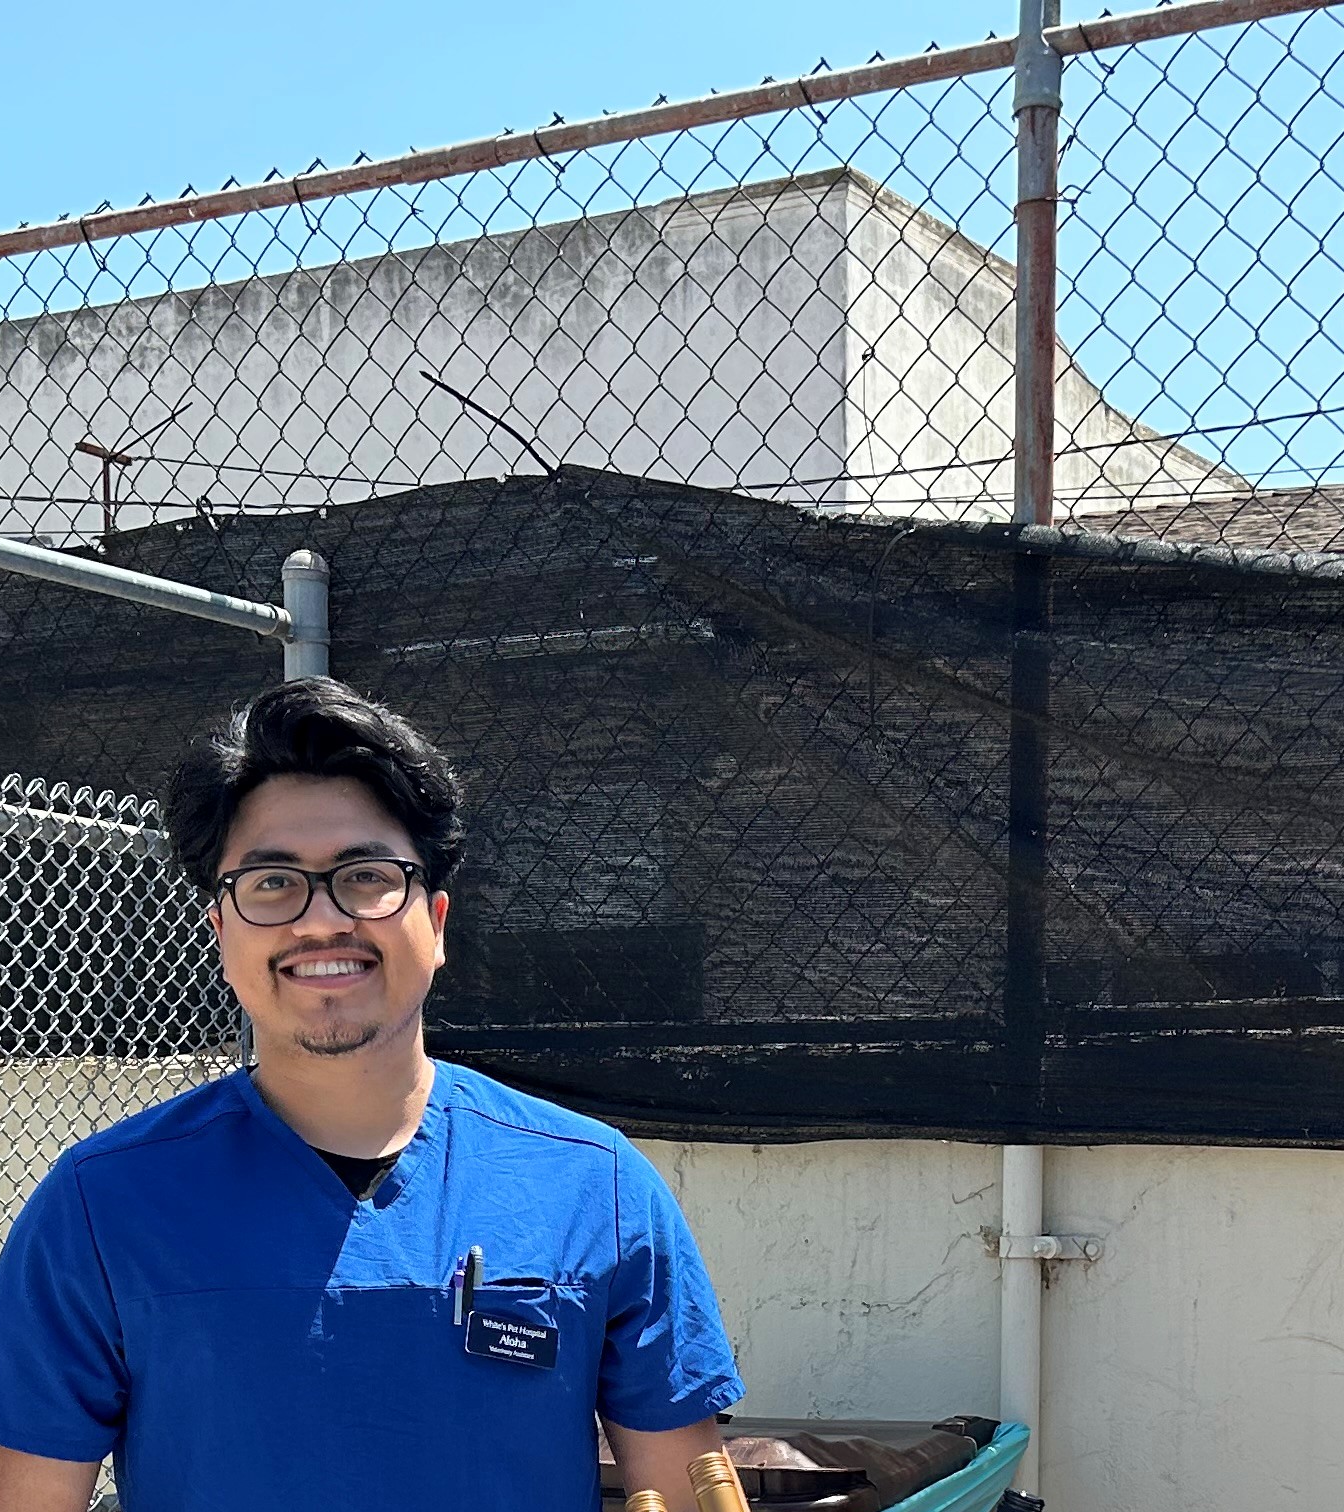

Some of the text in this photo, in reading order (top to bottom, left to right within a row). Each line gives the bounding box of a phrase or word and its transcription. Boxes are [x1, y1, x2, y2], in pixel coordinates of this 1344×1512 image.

[507, 1324, 518, 1333] Pet
[519, 1326, 547, 1339] Hospital
[499, 1334, 527, 1349] Aloha
